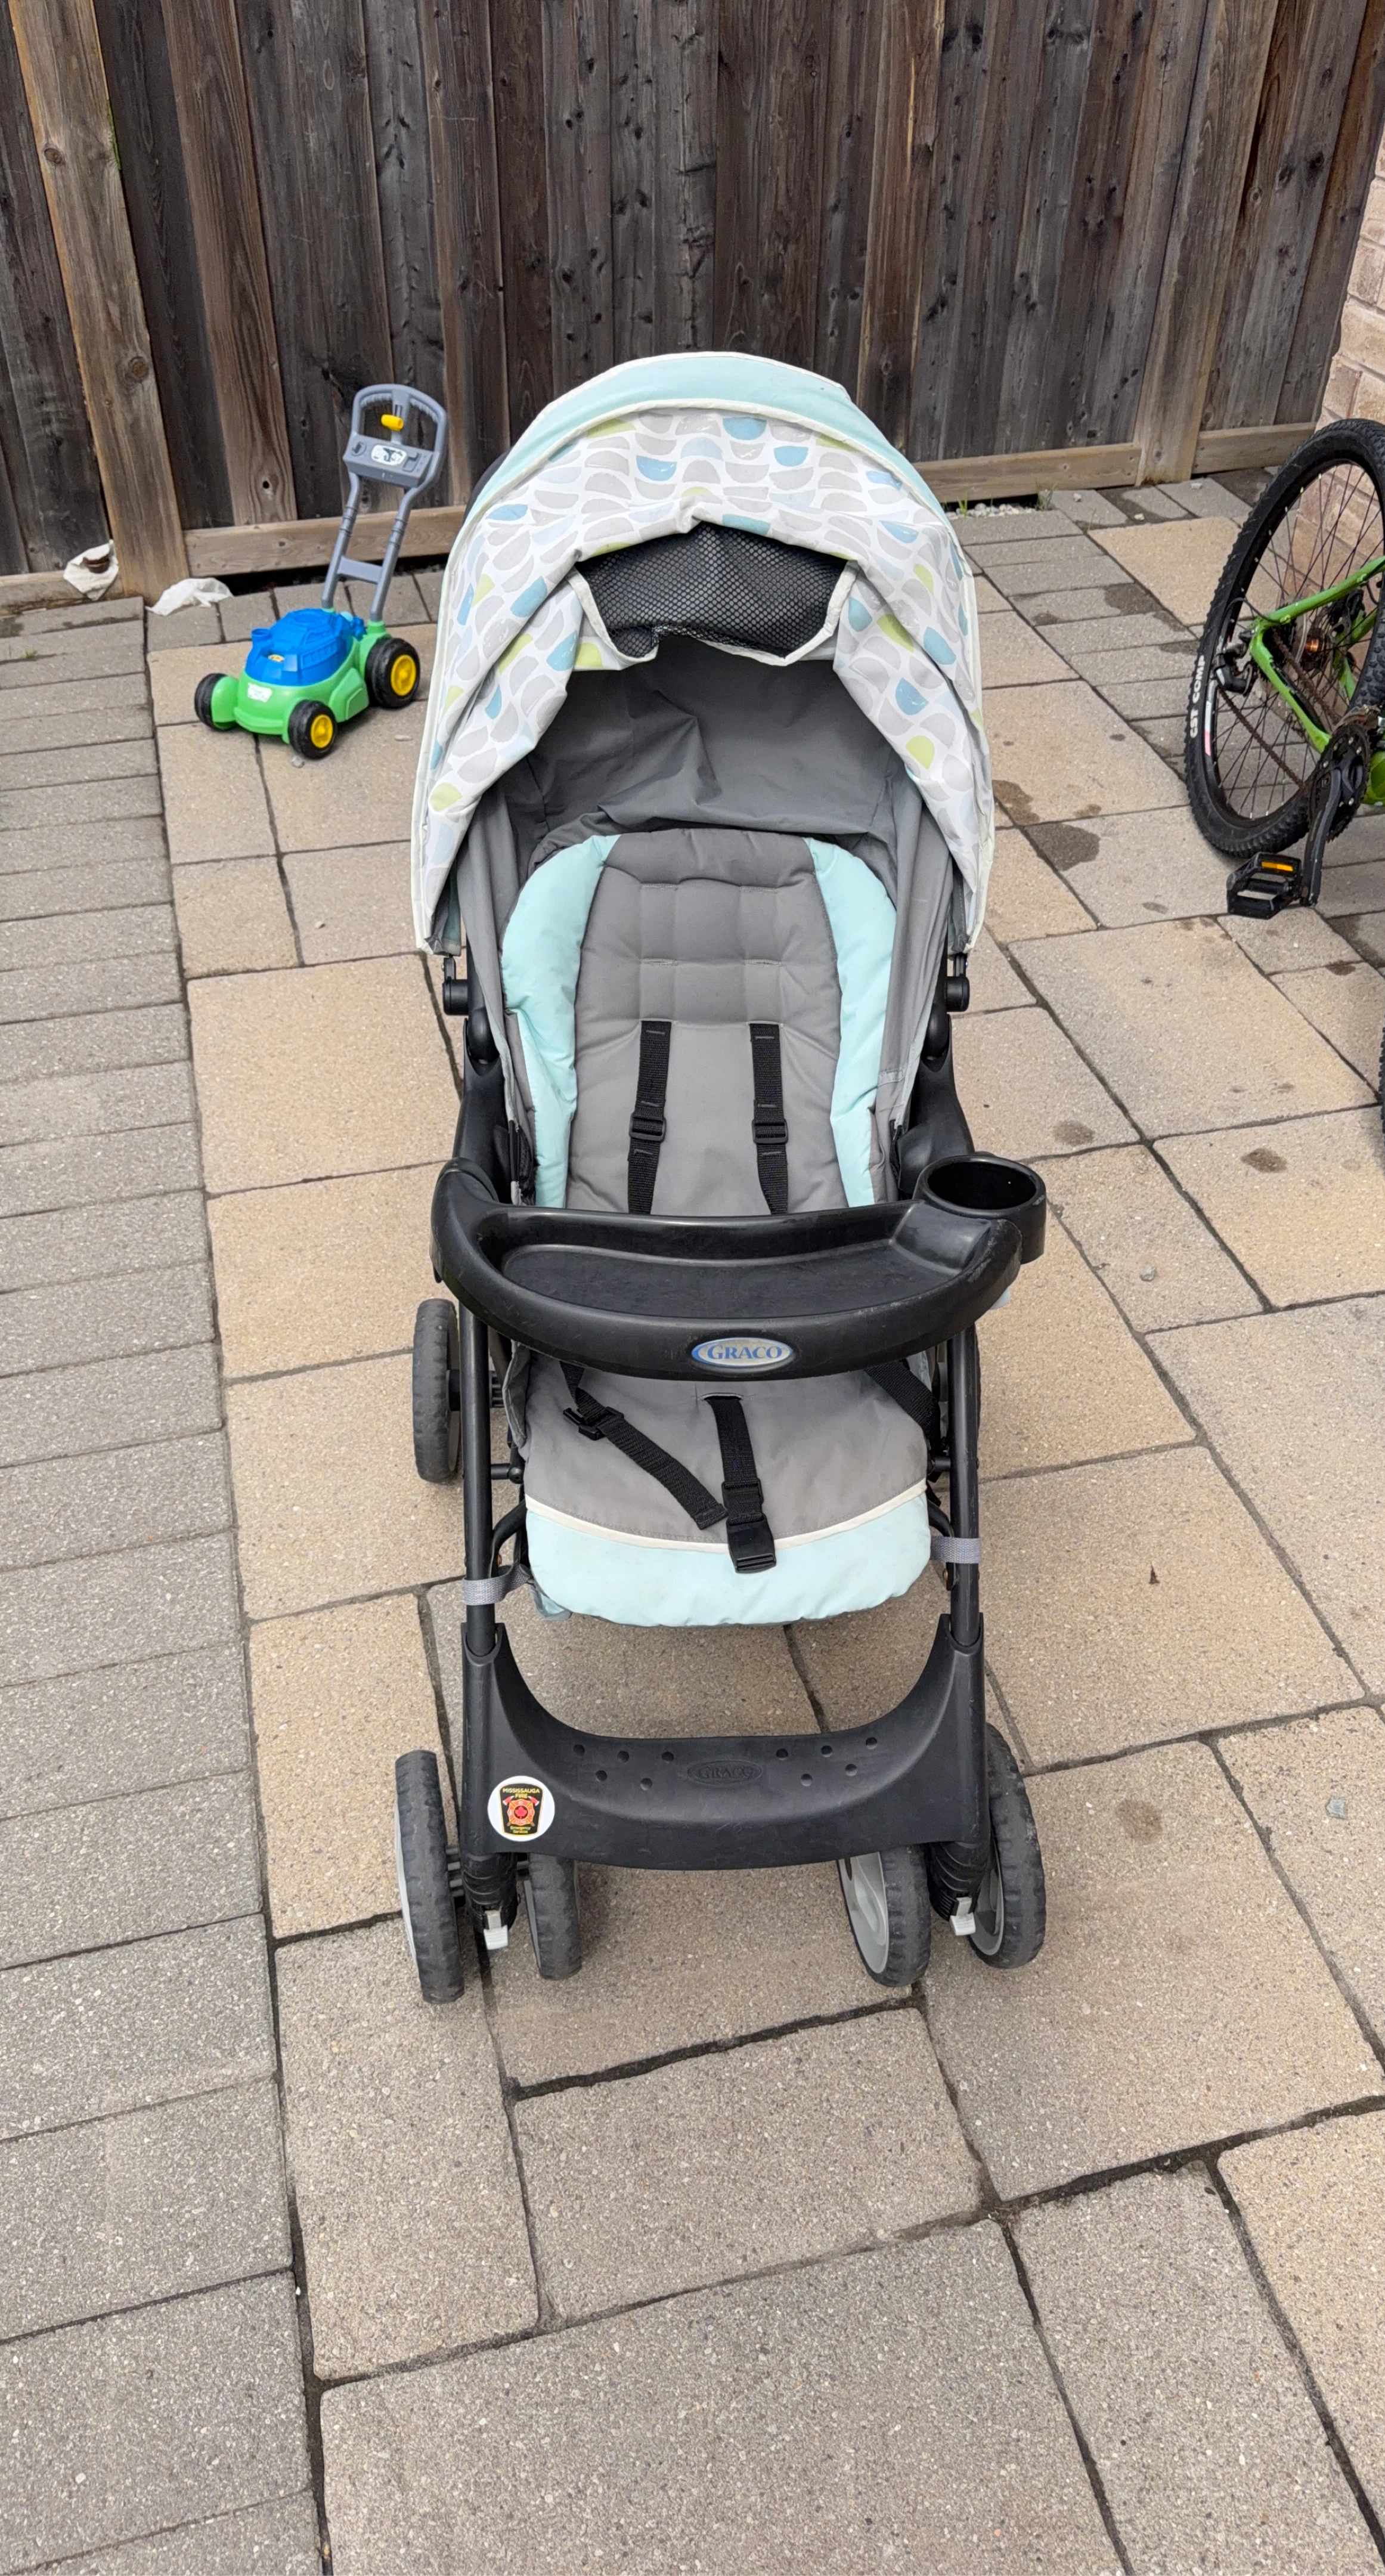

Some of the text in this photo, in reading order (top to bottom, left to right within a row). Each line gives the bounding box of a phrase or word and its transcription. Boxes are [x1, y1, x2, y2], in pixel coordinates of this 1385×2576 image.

[1190, 655, 1205, 738] CST COMP
[707, 1345, 783, 1360] GRACO
[698, 1766, 754, 1779] GRACO
